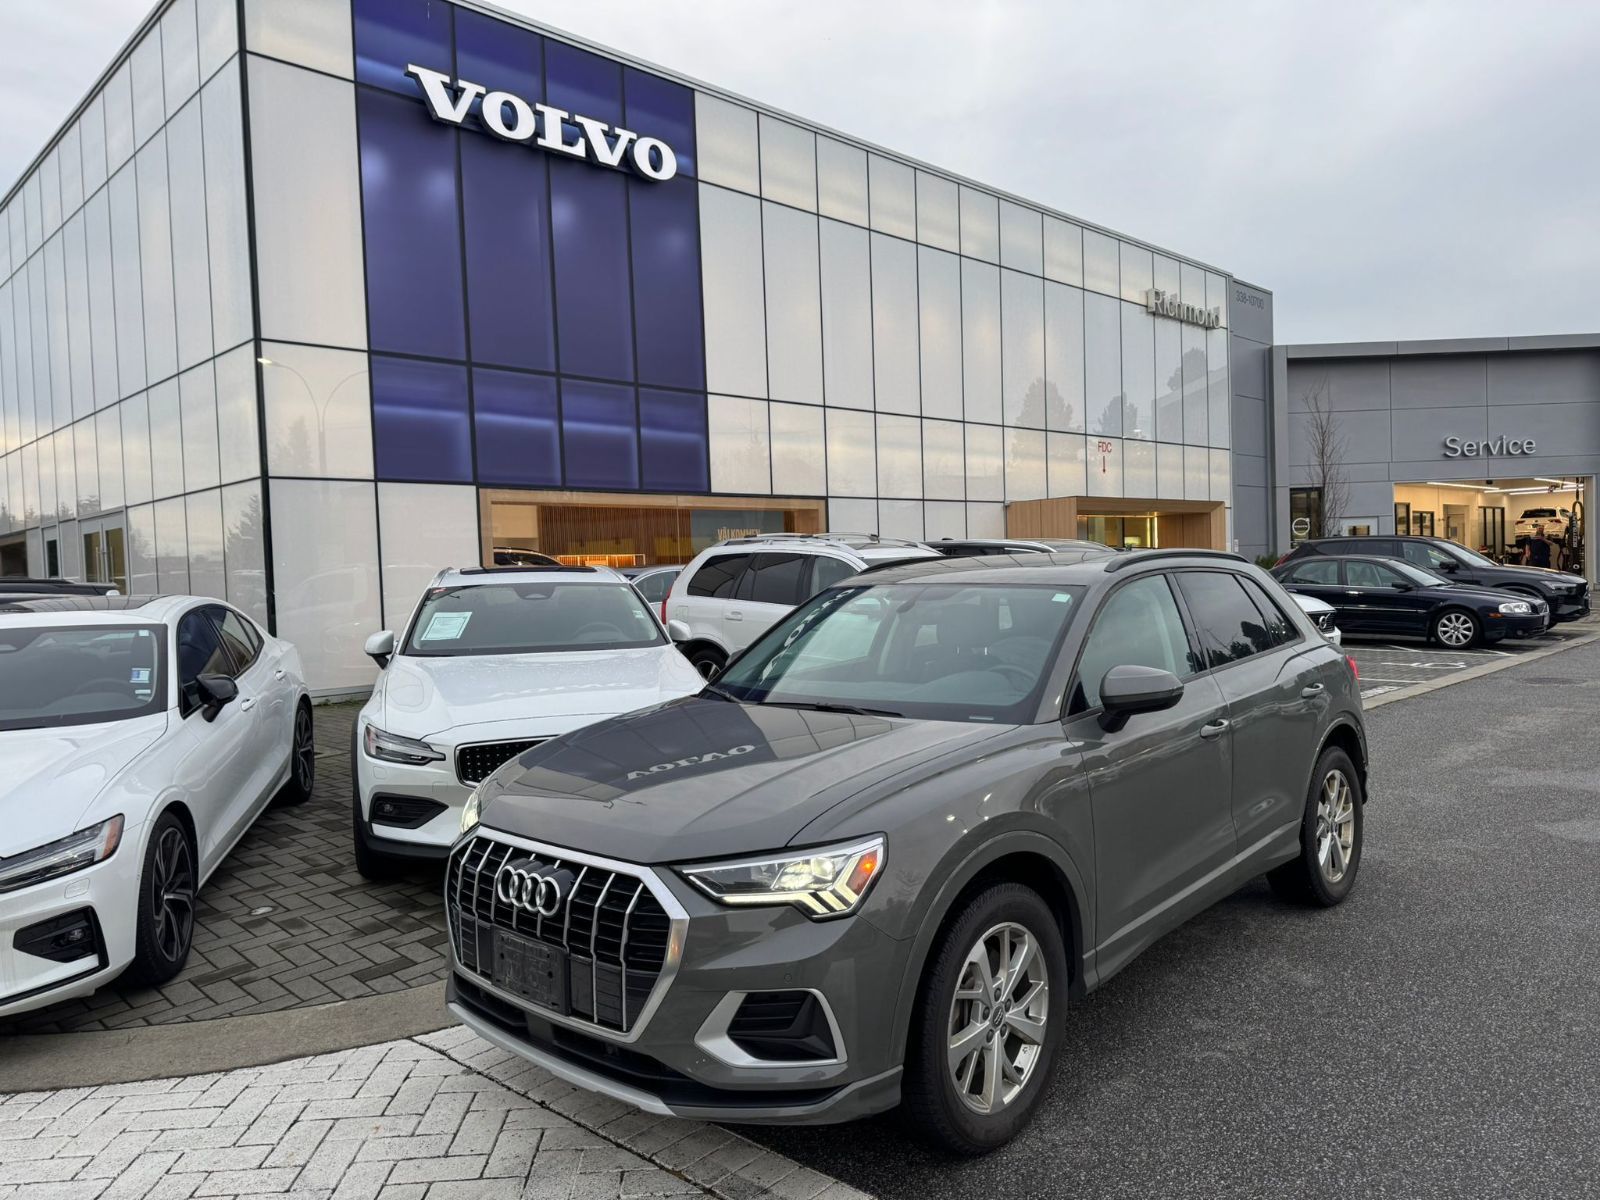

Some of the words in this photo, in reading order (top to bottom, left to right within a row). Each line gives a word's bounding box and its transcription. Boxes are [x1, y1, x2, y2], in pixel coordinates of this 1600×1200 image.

[405, 63, 678, 181] VOLVO
[1147, 287, 1221, 329] Richmond
[1097, 441, 1112, 453] FDC
[1444, 434, 1537, 457] Service
